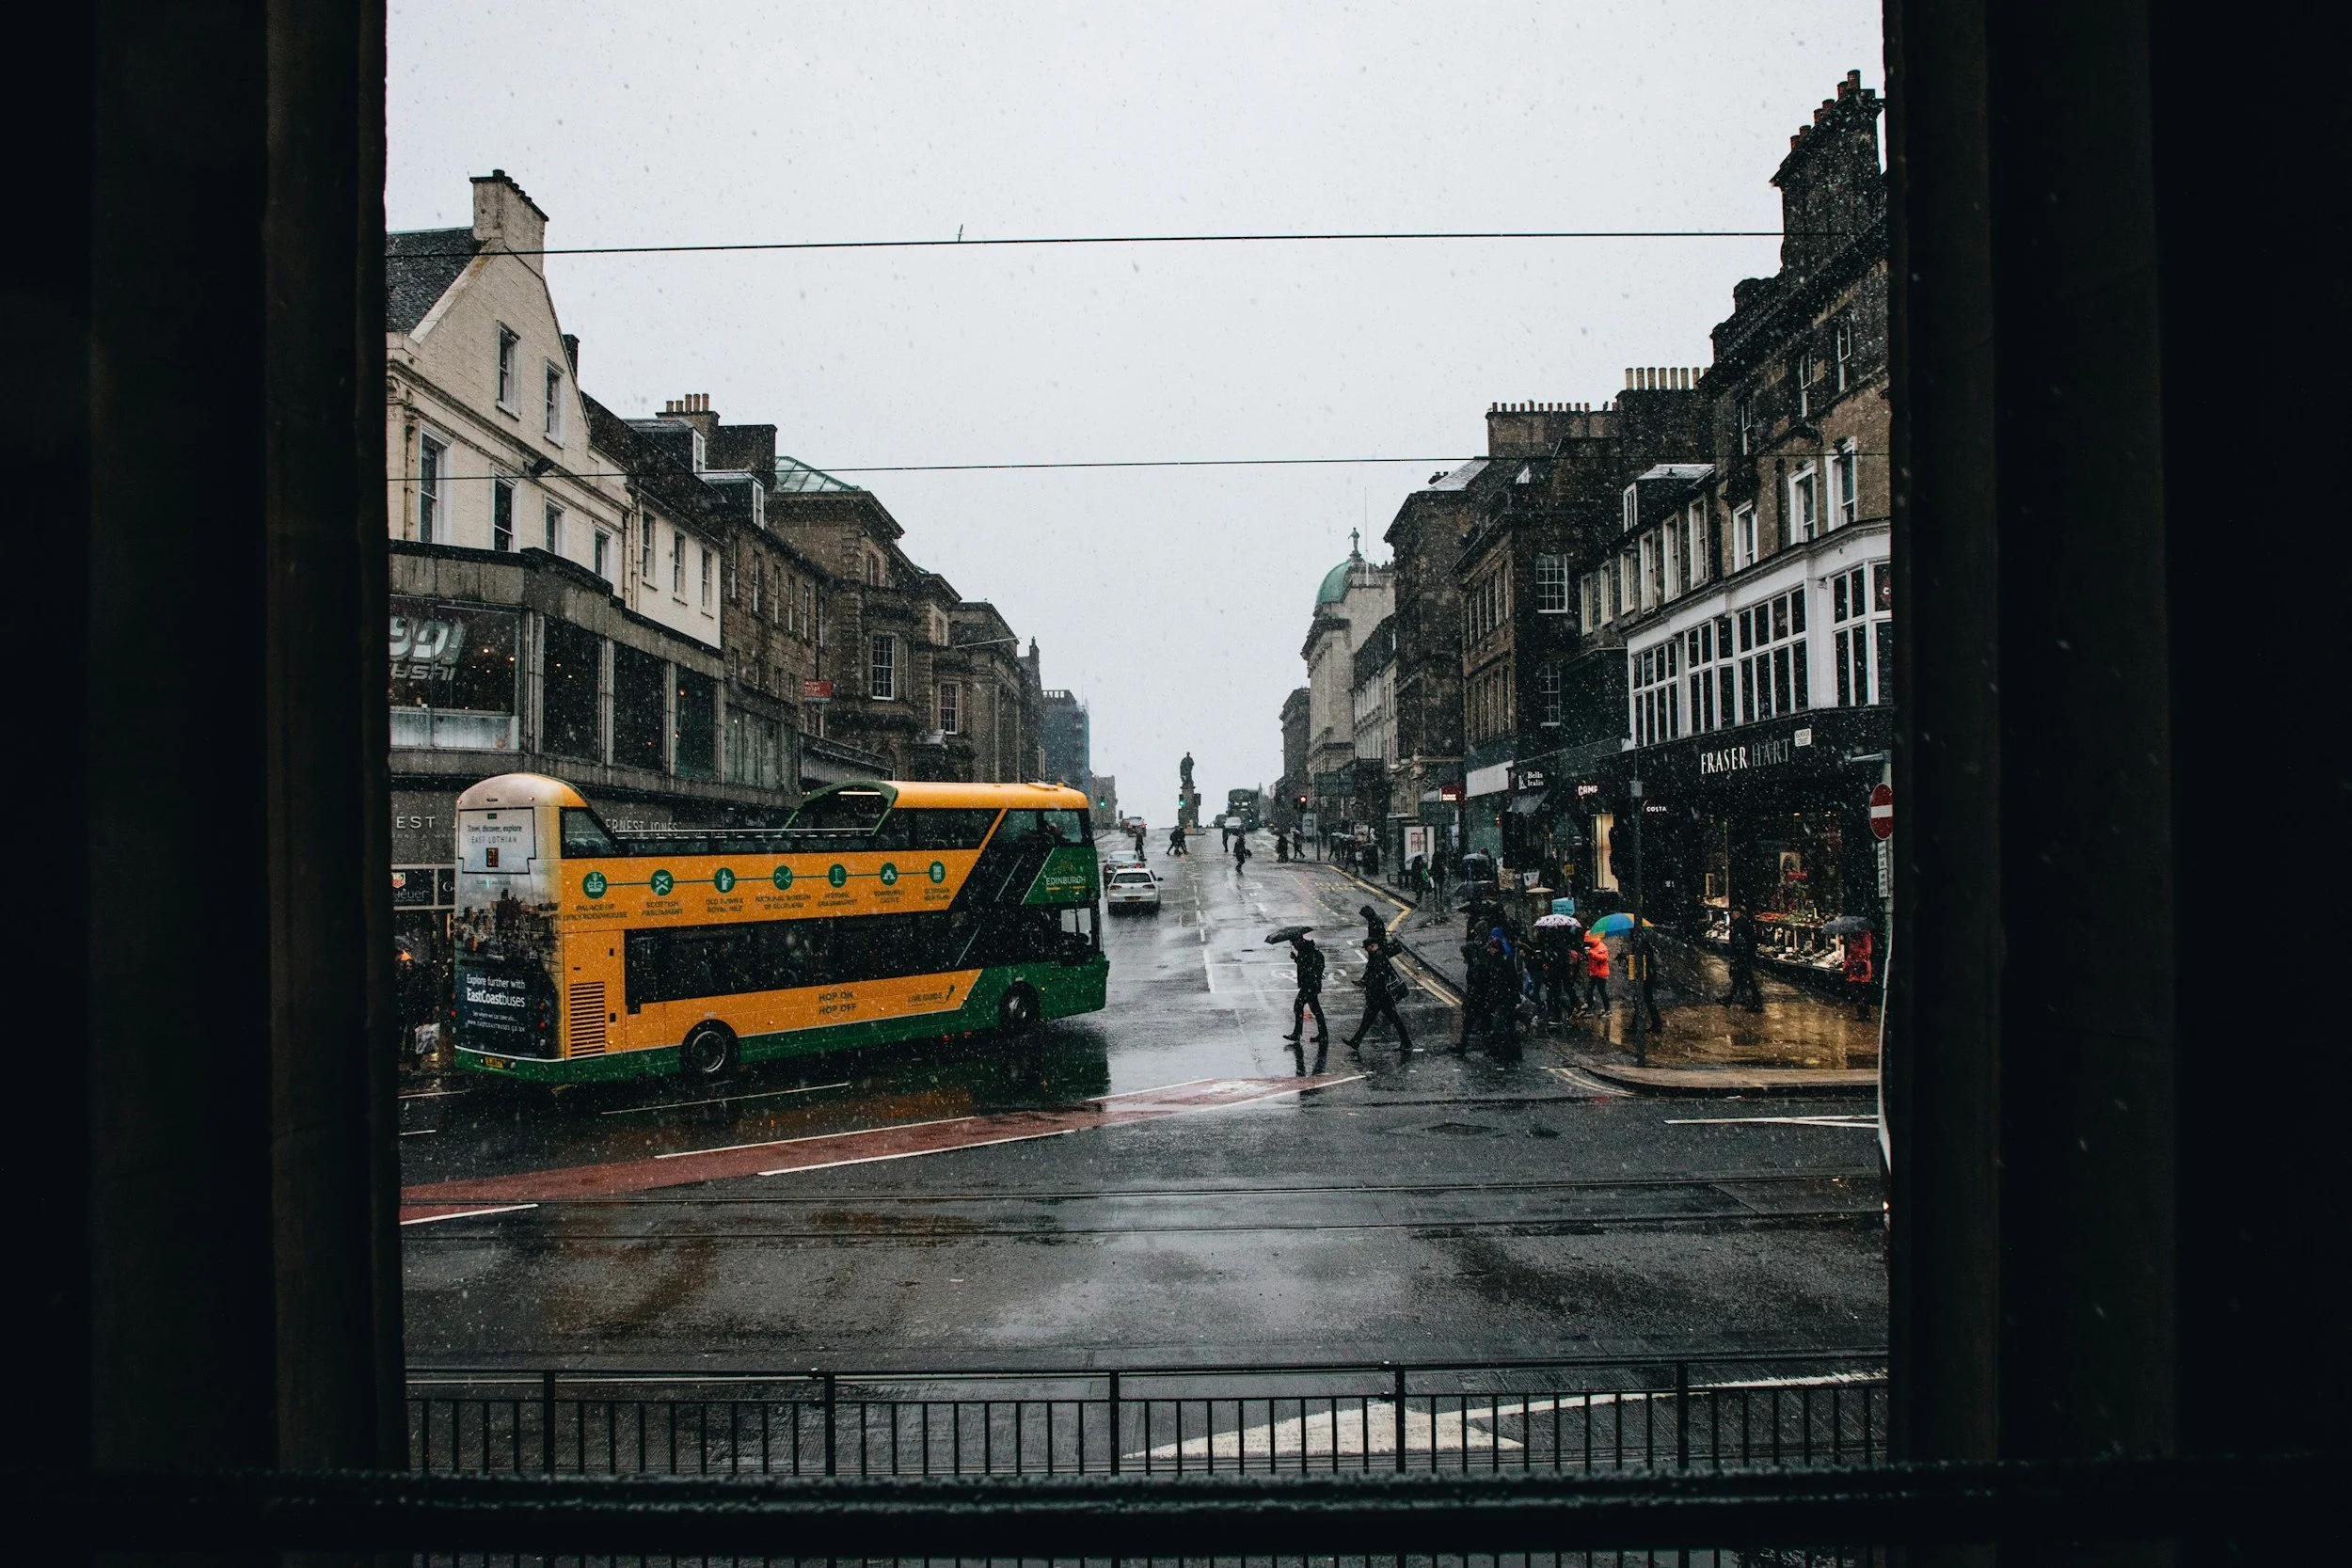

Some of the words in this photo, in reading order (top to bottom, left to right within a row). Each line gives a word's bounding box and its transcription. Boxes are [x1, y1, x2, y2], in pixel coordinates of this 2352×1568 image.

[1701, 746, 1748, 775] FRASER
[1752, 738, 1790, 768] HART
[471, 835, 486, 844] EAST
[488, 835, 517, 844] LOTHIAN
[1046, 876, 1086, 884] EDINBURGH
[467, 974, 486, 987] Explore
[487, 976, 509, 988] further
[510, 979, 526, 990] with
[467, 988, 526, 1007] EastCoastbuses
[818, 993, 837, 1003] HOP
[840, 991, 853, 1000] ON
[819, 1006, 838, 1015] HOP
[840, 1003, 857, 1013] OFF
